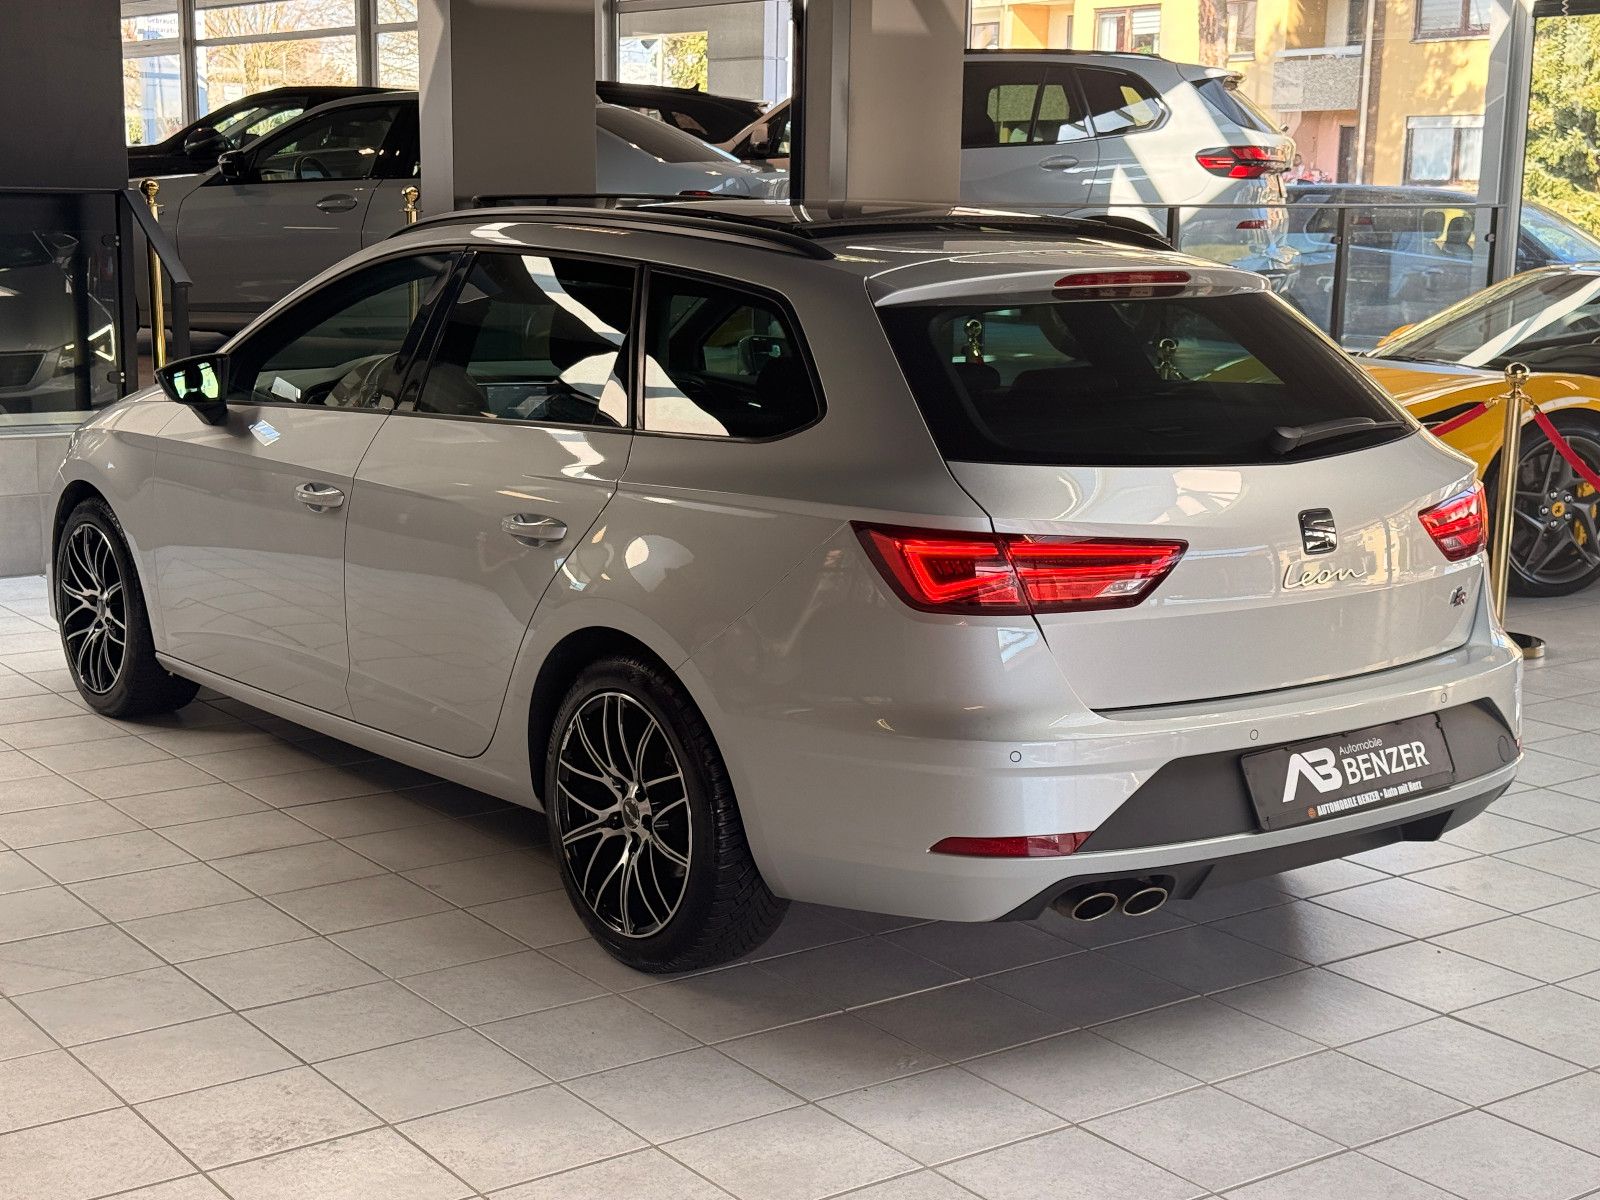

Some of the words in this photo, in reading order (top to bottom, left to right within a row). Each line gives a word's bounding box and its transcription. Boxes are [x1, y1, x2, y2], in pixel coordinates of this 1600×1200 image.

[1282, 561, 1367, 589] Leon
[1339, 737, 1383, 756] Automobile
[1341, 741, 1430, 785] BENZER
[1317, 796, 1358, 817] AUTOMOBILE
[1357, 790, 1381, 806] BENZER
[1383, 787, 1398, 799] Auto
[1397, 783, 1409, 795] mit
[1407, 780, 1423, 792] Herz
